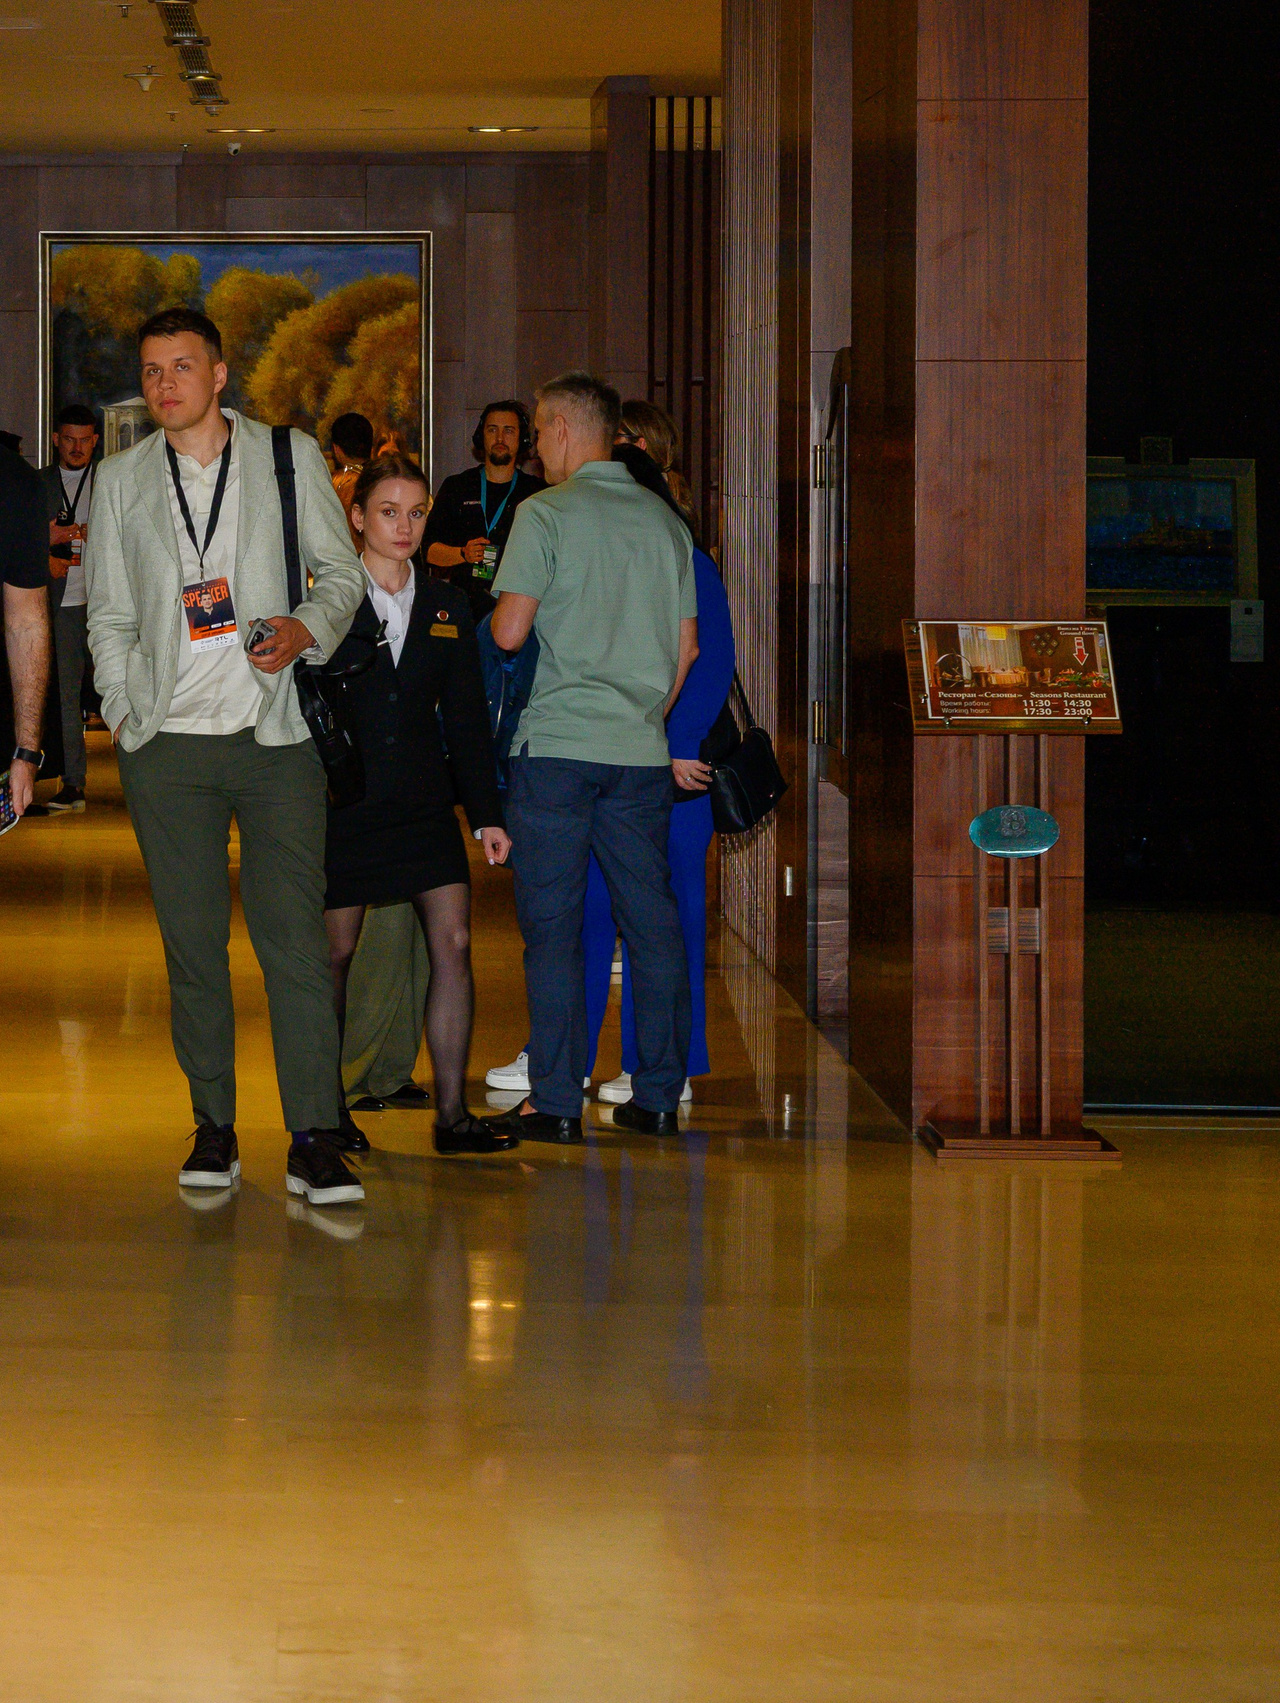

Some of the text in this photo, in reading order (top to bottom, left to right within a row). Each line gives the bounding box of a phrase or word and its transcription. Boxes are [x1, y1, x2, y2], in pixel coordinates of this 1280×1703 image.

[182, 585, 229, 607] SPEKER
[938, 691, 977, 699] Ресторан
[1023, 699, 1051, 707] 11:30
[1063, 699, 1091, 707] 14:30
